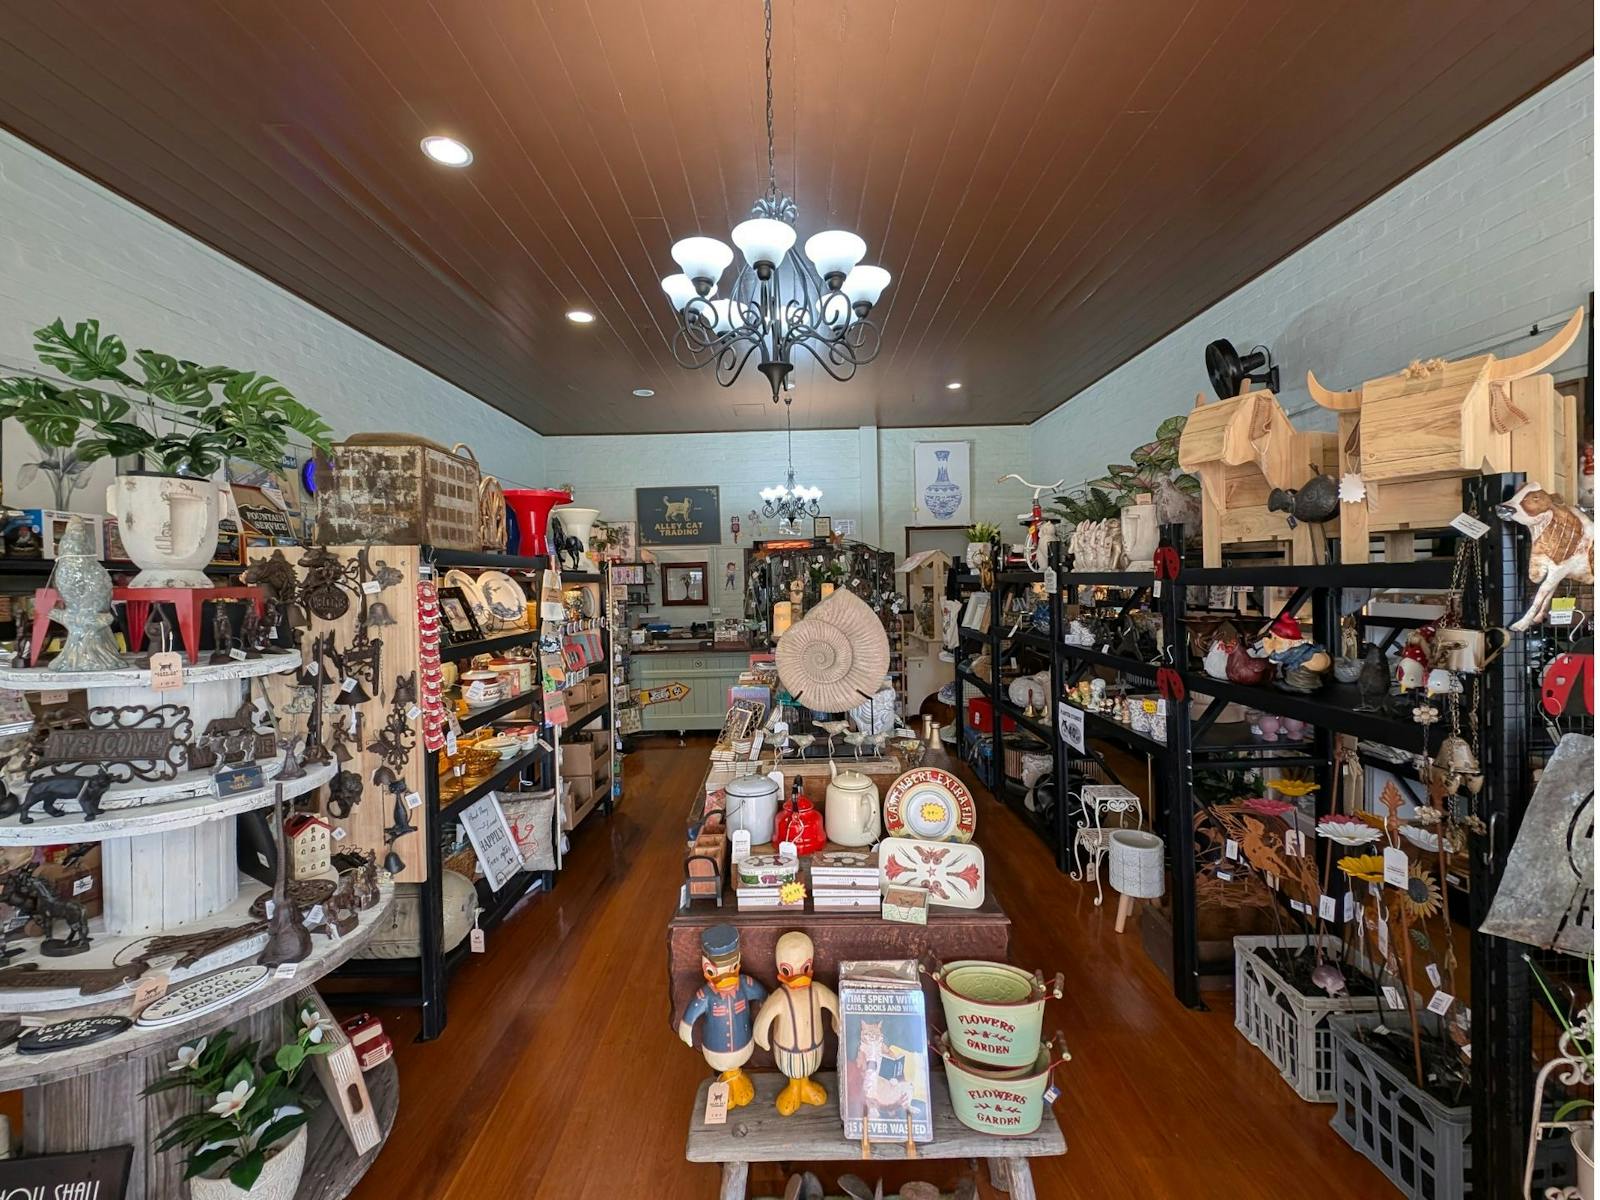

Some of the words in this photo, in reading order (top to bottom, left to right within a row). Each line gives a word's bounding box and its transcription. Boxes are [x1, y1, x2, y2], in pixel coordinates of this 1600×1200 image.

[246, 511, 286, 522] FOUNTAIN
[254, 521, 288, 531] SERVICE
[654, 522, 682, 530] ALLEY
[685, 521, 704, 529] CAT
[480, 828, 505, 852] HAPPILY
[230, 967, 250, 975] THE
[180, 980, 240, 1006] BEWARE
[182, 980, 228, 1000] DOG
[847, 994, 867, 1004] TIME
[867, 994, 894, 1004] SPENT
[162, 1008, 181, 1017] OF
[187, 998, 213, 1010] THE
[864, 1004, 887, 1012] BOOKS
[958, 1014, 1016, 1033] FLOWERS
[38, 1028, 97, 1043] GATE
[982, 1031, 991, 1039] &
[966, 1038, 1010, 1054] GARDEN
[968, 1089, 1028, 1105] FLOWERS
[995, 1104, 1002, 1112] &
[976, 1112, 1021, 1126] GARDEN
[849, 1123, 858, 1135] IS
[890, 1124, 927, 1135] WASED
